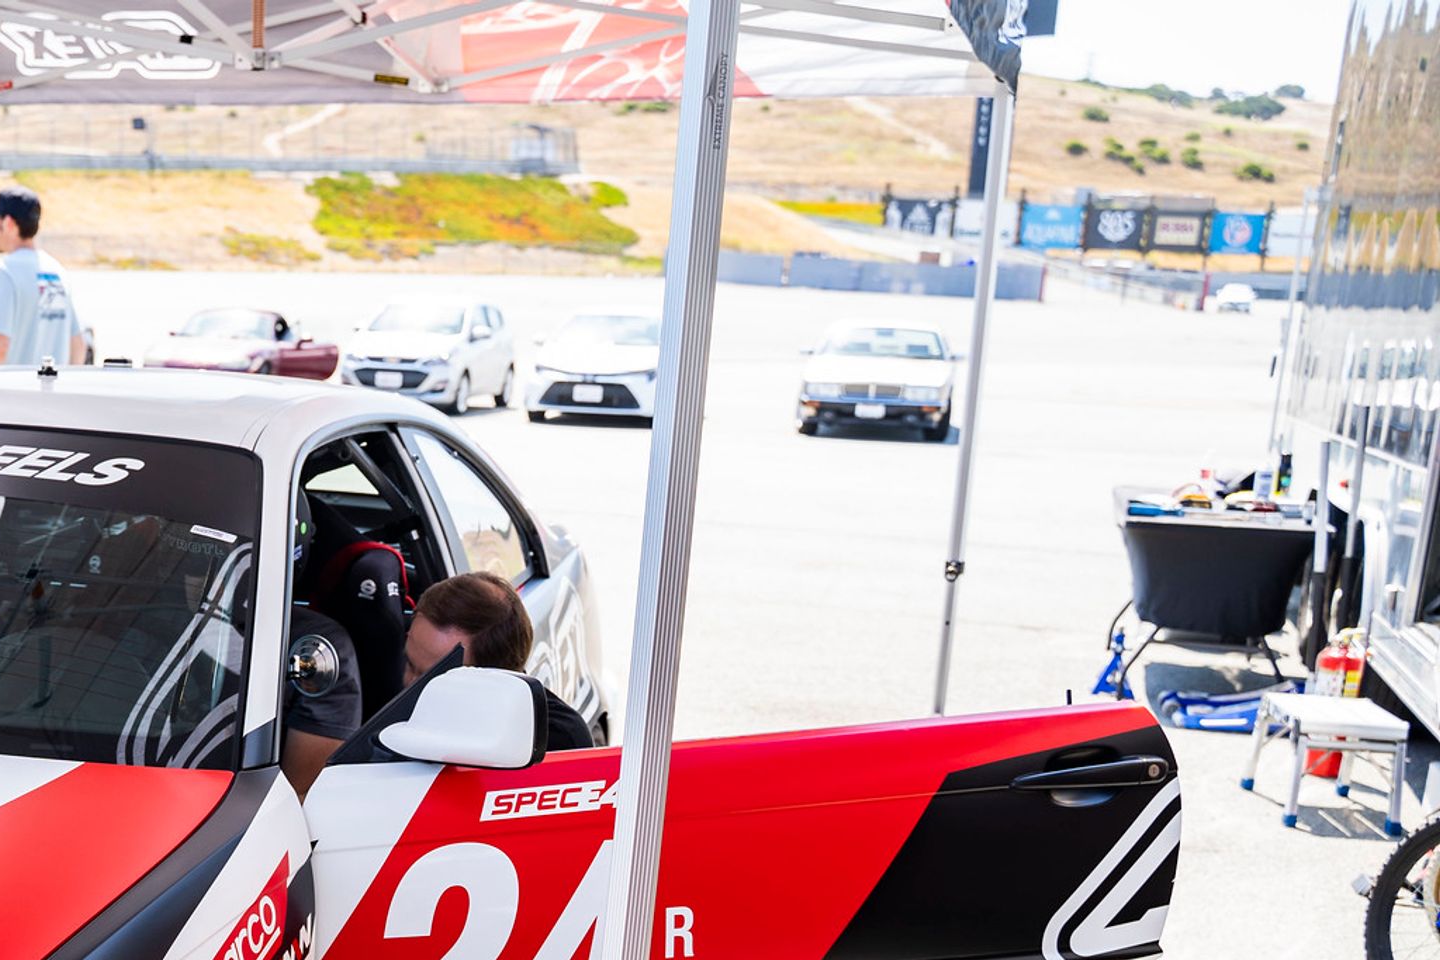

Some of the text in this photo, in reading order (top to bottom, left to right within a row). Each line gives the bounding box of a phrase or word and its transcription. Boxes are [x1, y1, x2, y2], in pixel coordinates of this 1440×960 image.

[712, 51, 729, 150] EXTREME CANOPY
[491, 786, 583, 816] SPEC
[663, 905, 696, 960] R
